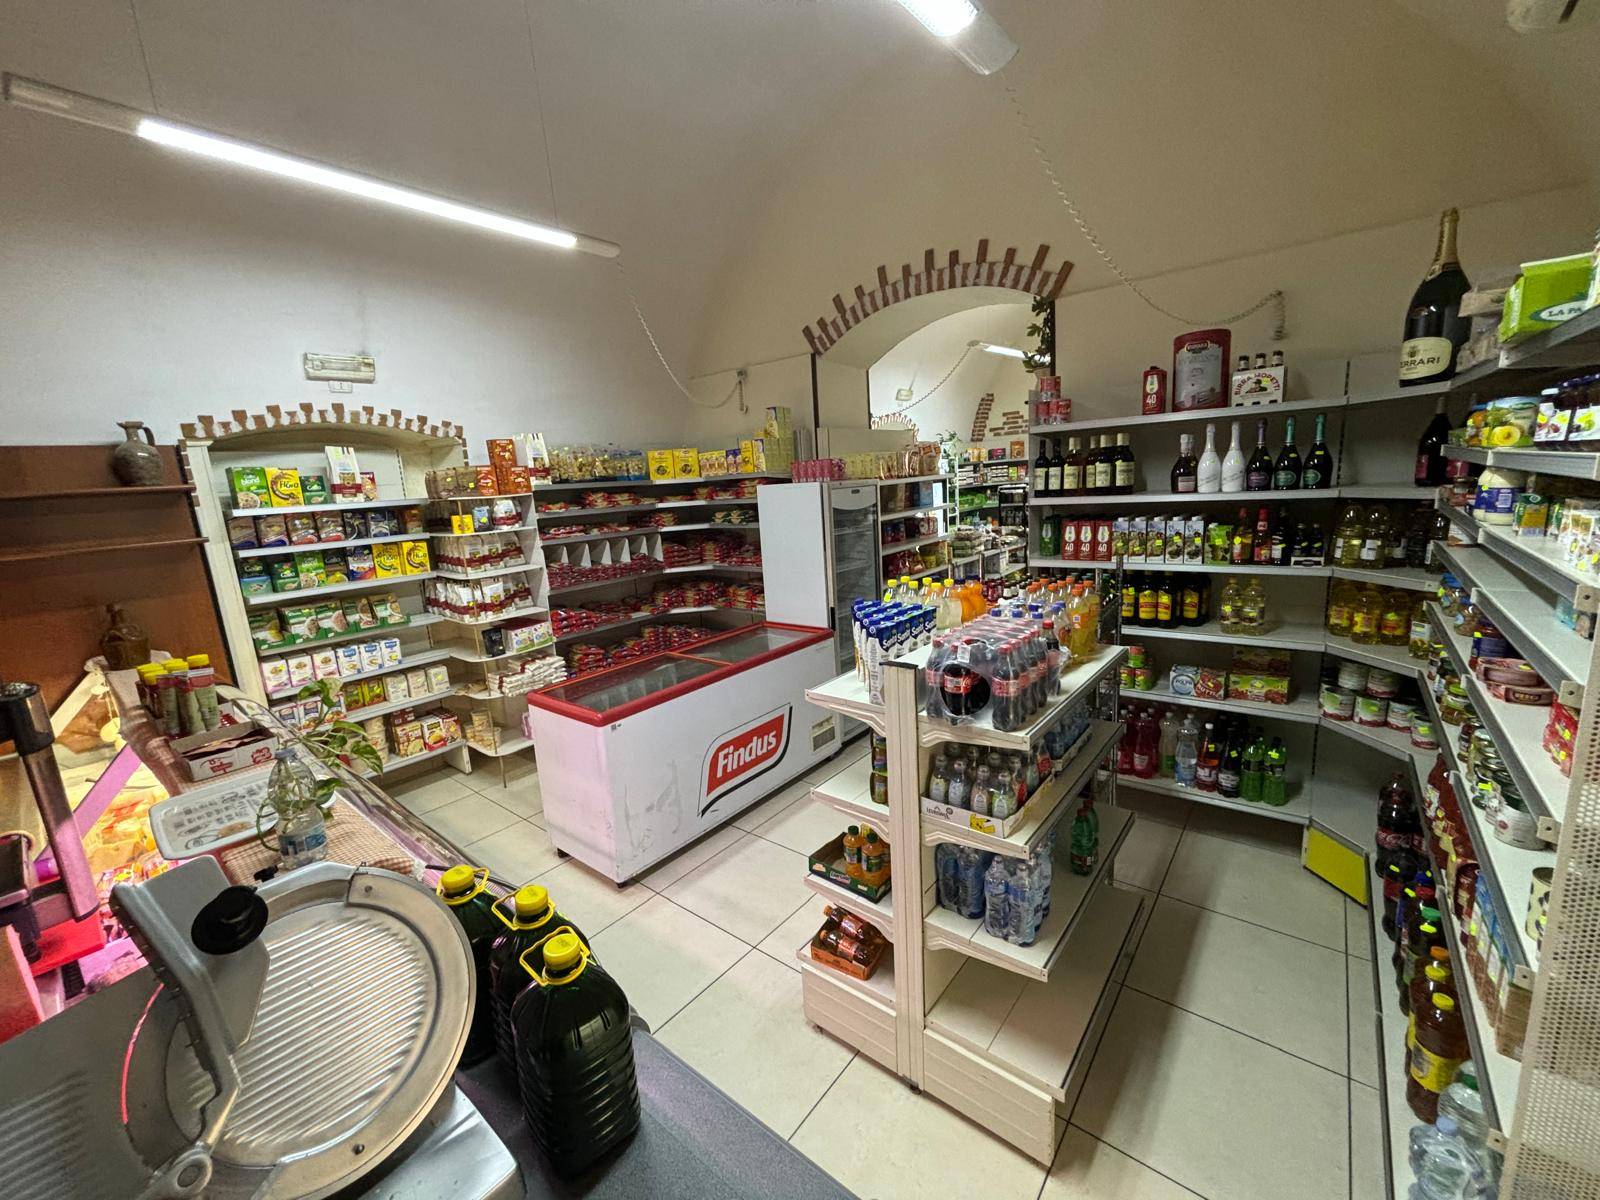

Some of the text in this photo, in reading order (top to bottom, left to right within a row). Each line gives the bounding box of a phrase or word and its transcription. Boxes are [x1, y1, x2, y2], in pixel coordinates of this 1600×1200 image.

[1567, 306, 1582, 315] PA
[1234, 372, 1280, 395] BIRRA MORETTI
[1146, 394, 1157, 405] 40
[1065, 543, 1074, 552] 40
[1081, 543, 1090, 552] 40
[1098, 543, 1108, 552] 40
[716, 730, 778, 778] Findus
